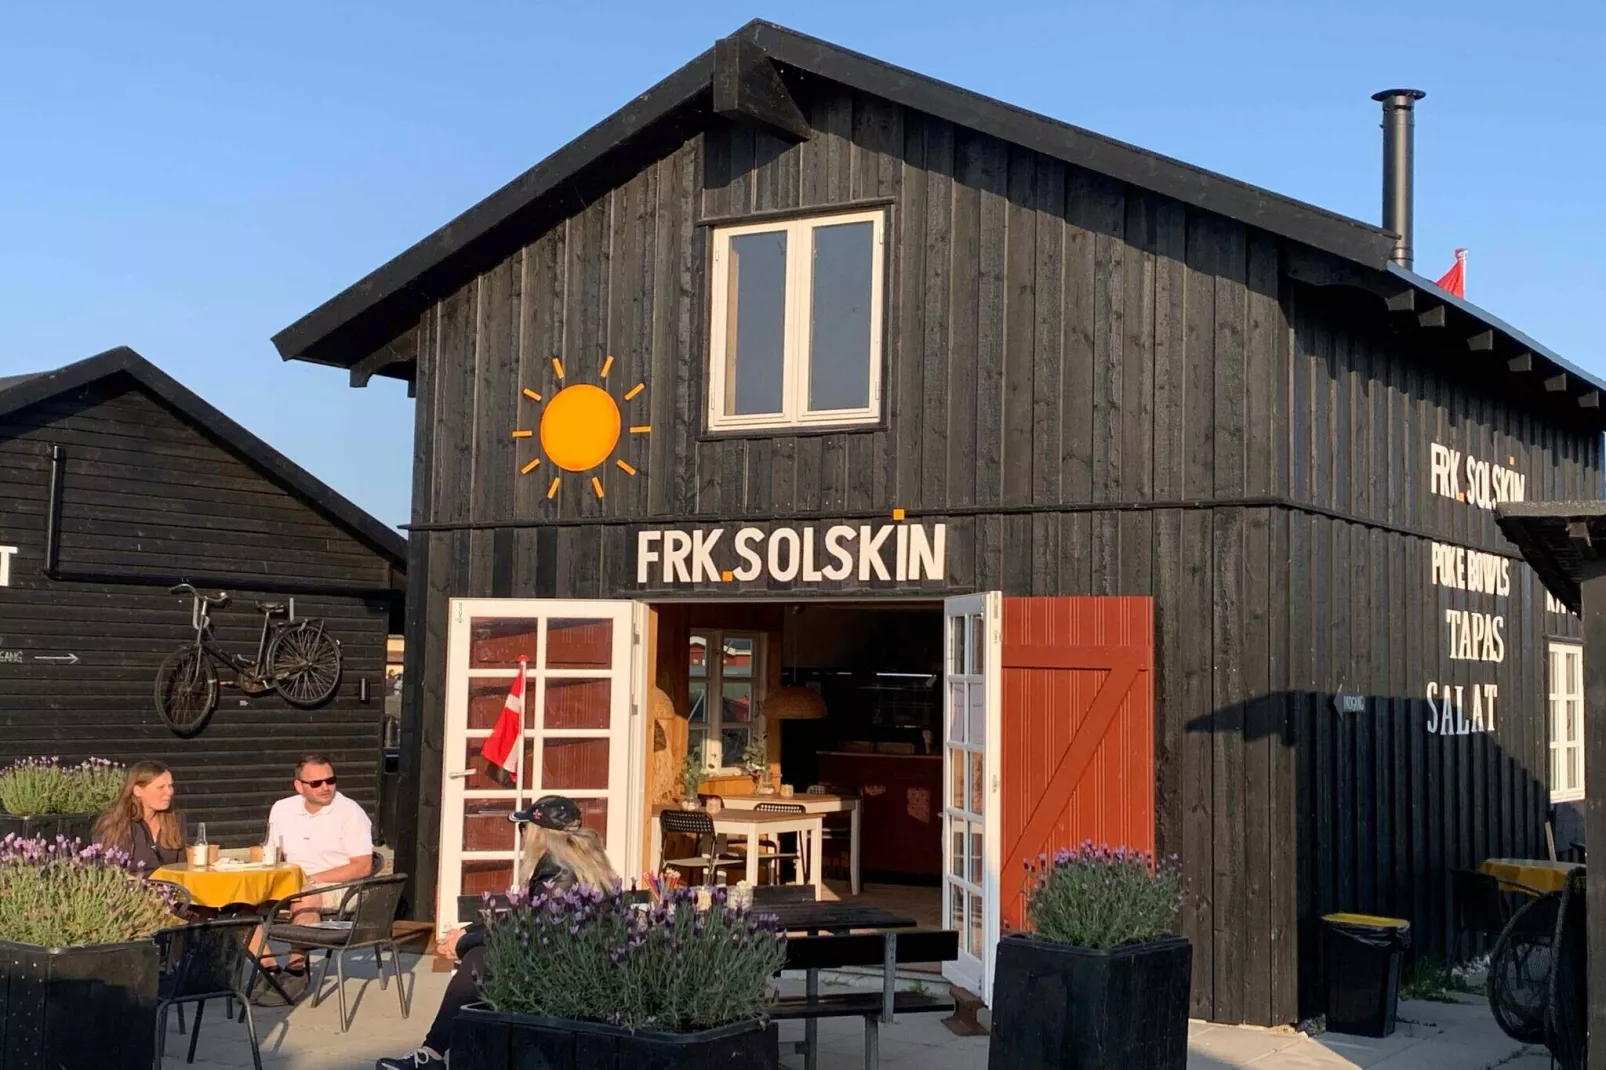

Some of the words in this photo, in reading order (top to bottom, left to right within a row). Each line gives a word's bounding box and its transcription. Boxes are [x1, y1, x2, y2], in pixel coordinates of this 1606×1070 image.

[1432, 541, 1465, 590] POKE
[1467, 549, 1510, 597] BOWLS
[1446, 609, 1504, 663] TAPAS
[1426, 681, 1498, 735] SALAT
